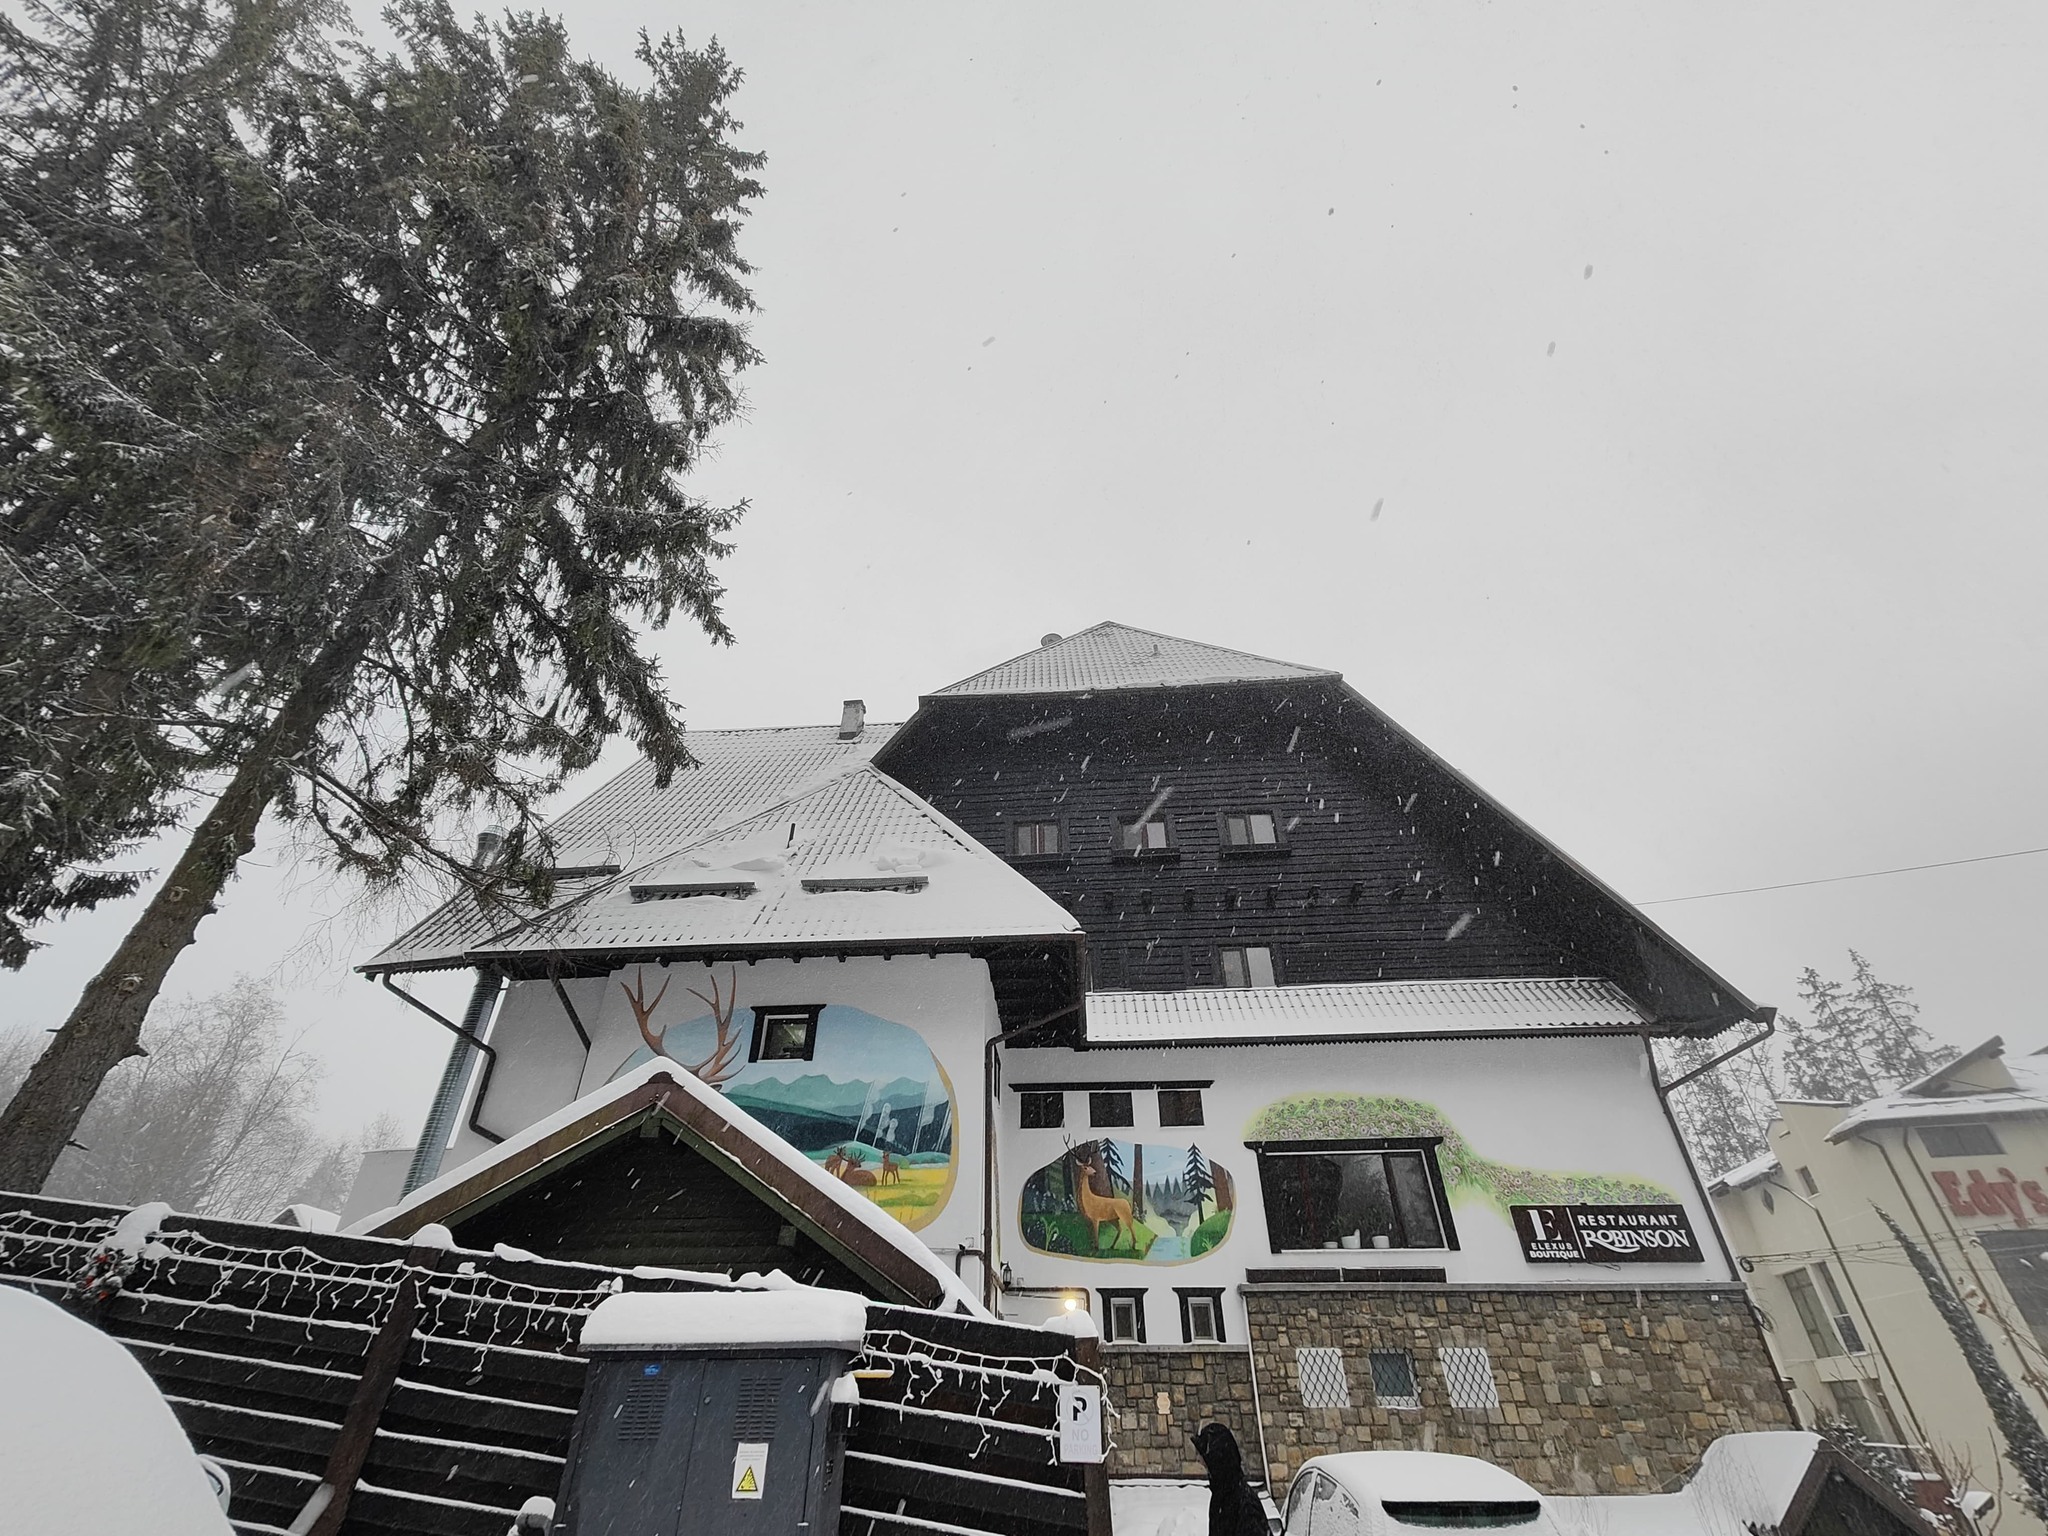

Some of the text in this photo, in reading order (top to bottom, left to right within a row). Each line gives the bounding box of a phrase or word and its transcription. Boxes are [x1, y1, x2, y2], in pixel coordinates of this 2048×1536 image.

[1931, 1167, 2048, 1229] Edy's
[1527, 1209, 1561, 1241] E
[1577, 1214, 1679, 1227] RESTAURANT
[1531, 1243, 1573, 1251] ELEXUS
[1580, 1229, 1690, 1253] ROBINSON
[1530, 1250, 1581, 1259] BOUTIQUE
[1072, 1396, 1088, 1422] P
[1072, 1429, 1090, 1442] NO
[1064, 1443, 1098, 1456] PARKING
